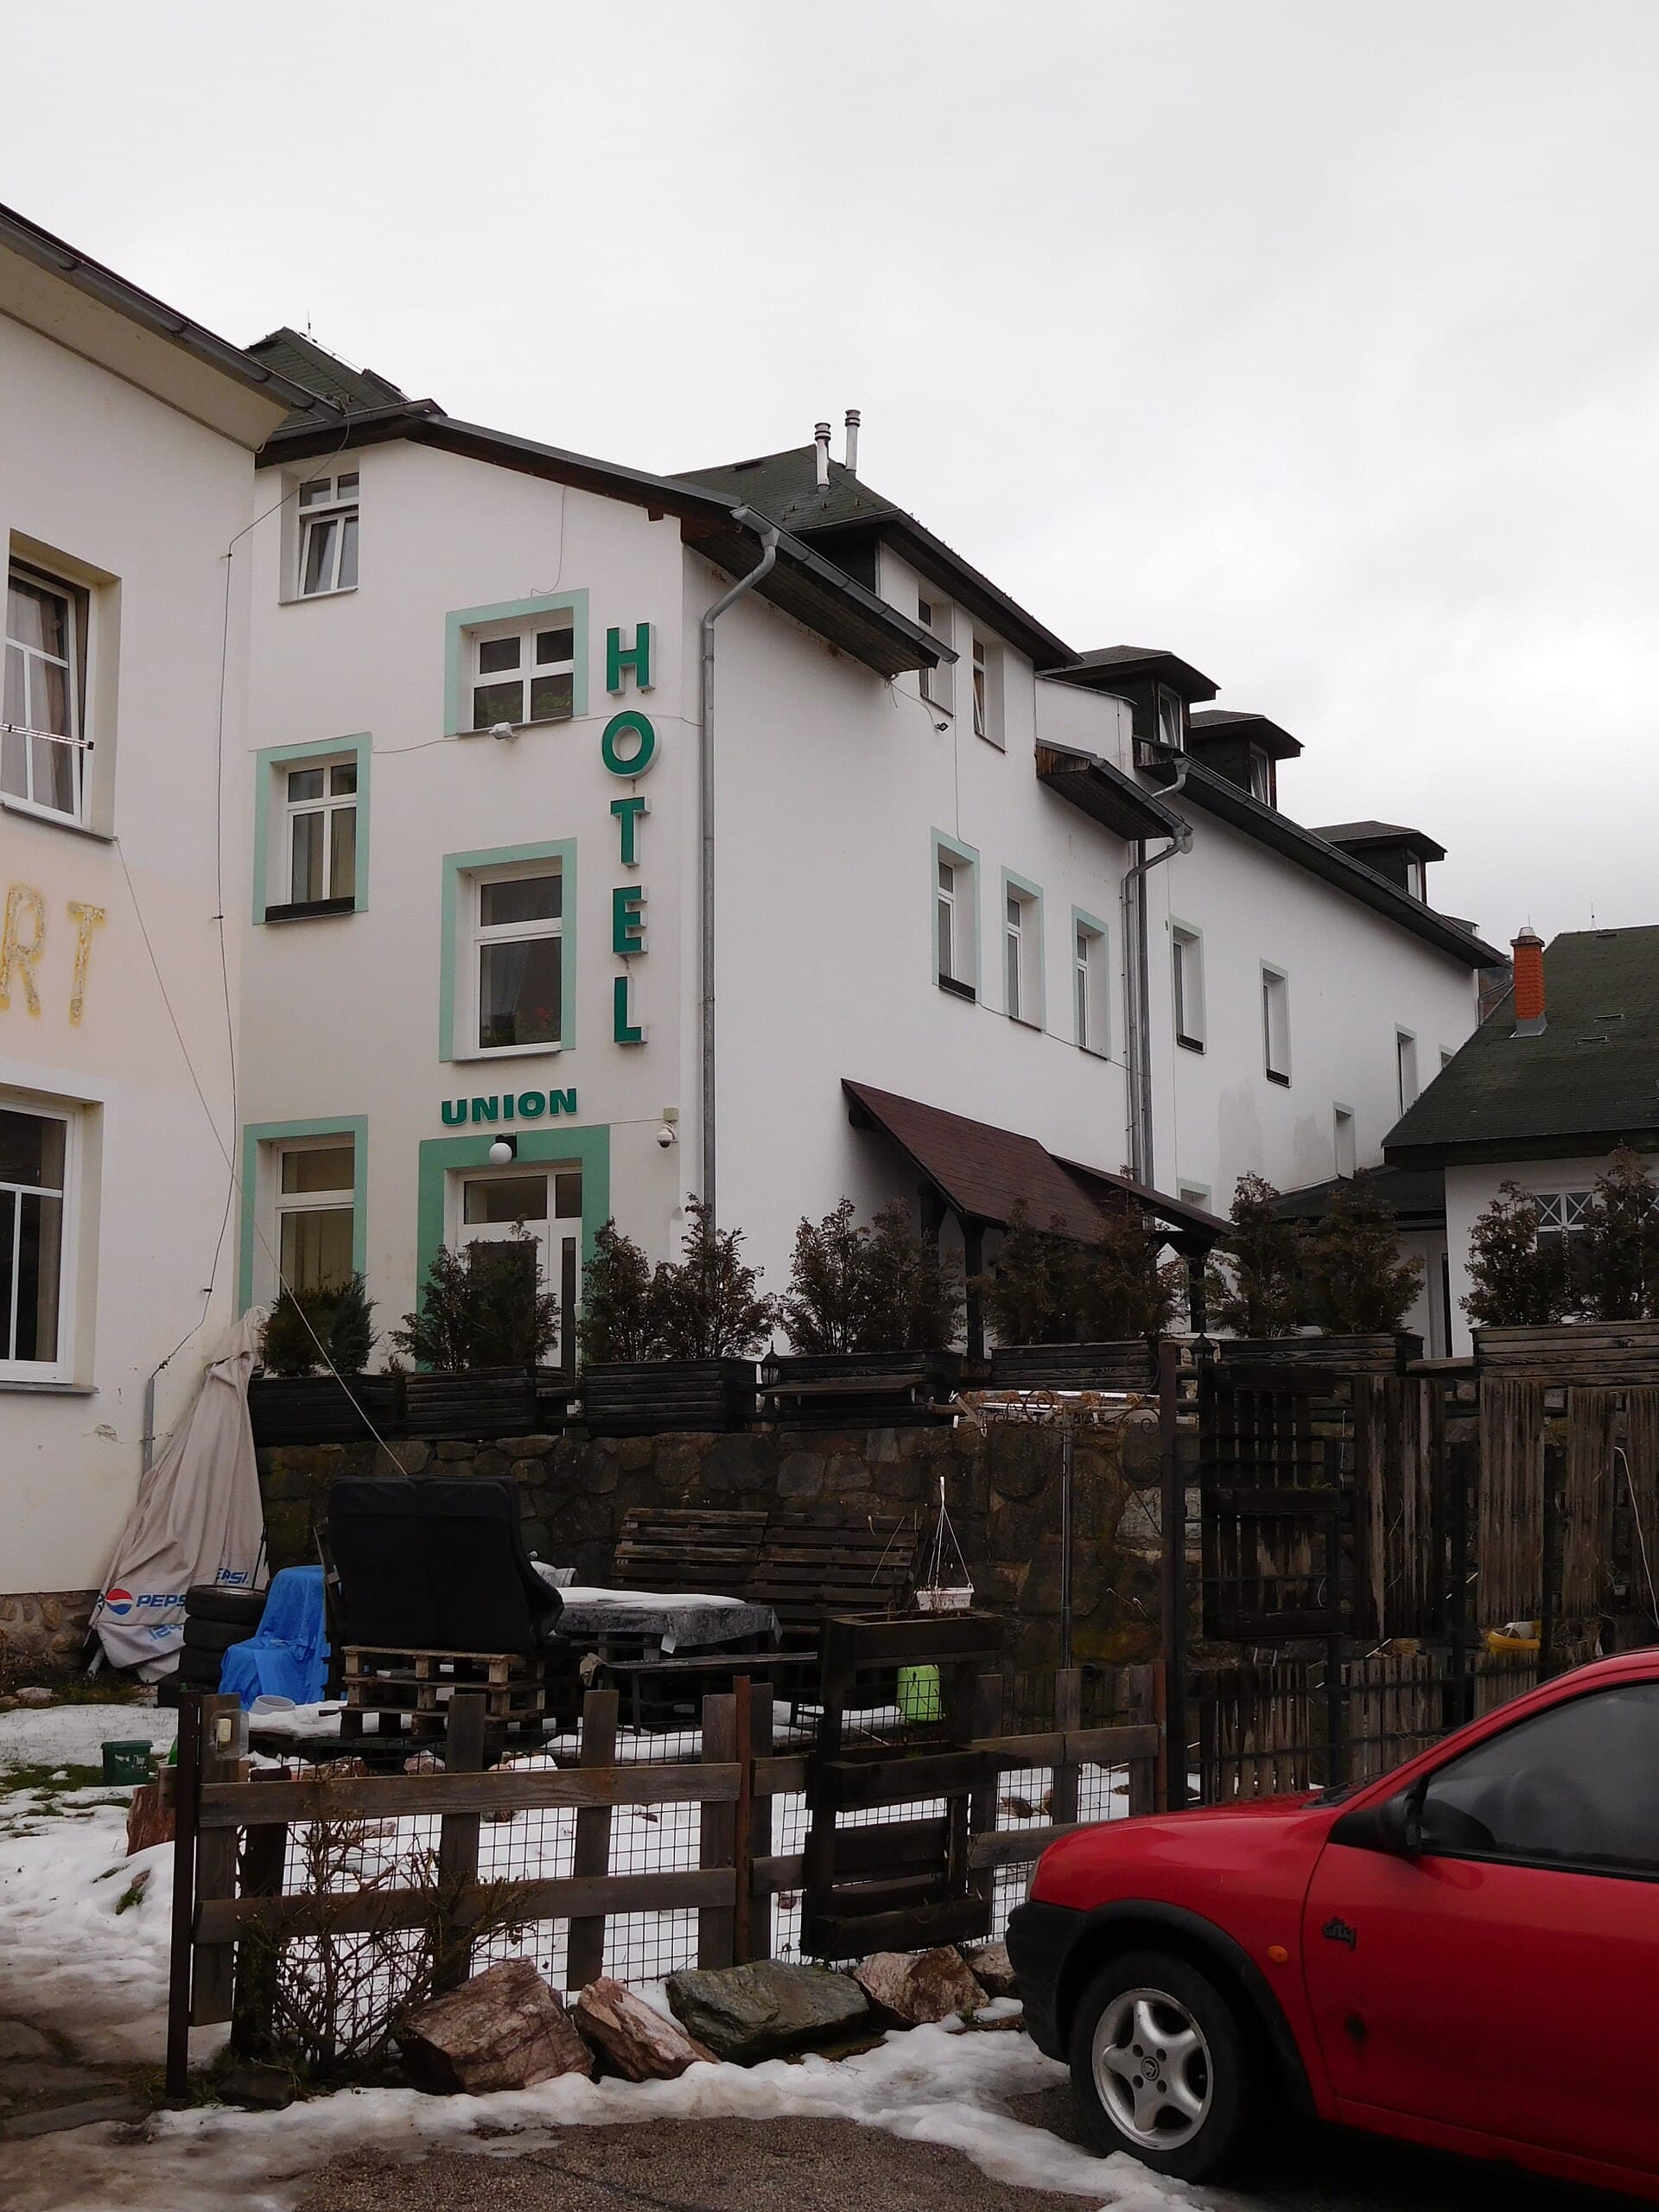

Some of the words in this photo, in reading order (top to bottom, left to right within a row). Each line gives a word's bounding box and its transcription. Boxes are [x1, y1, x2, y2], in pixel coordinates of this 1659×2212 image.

[602, 622, 659, 1046] HOTEL
[441, 1088, 578, 1127] UNION
[136, 1594, 187, 1608] PEPS
